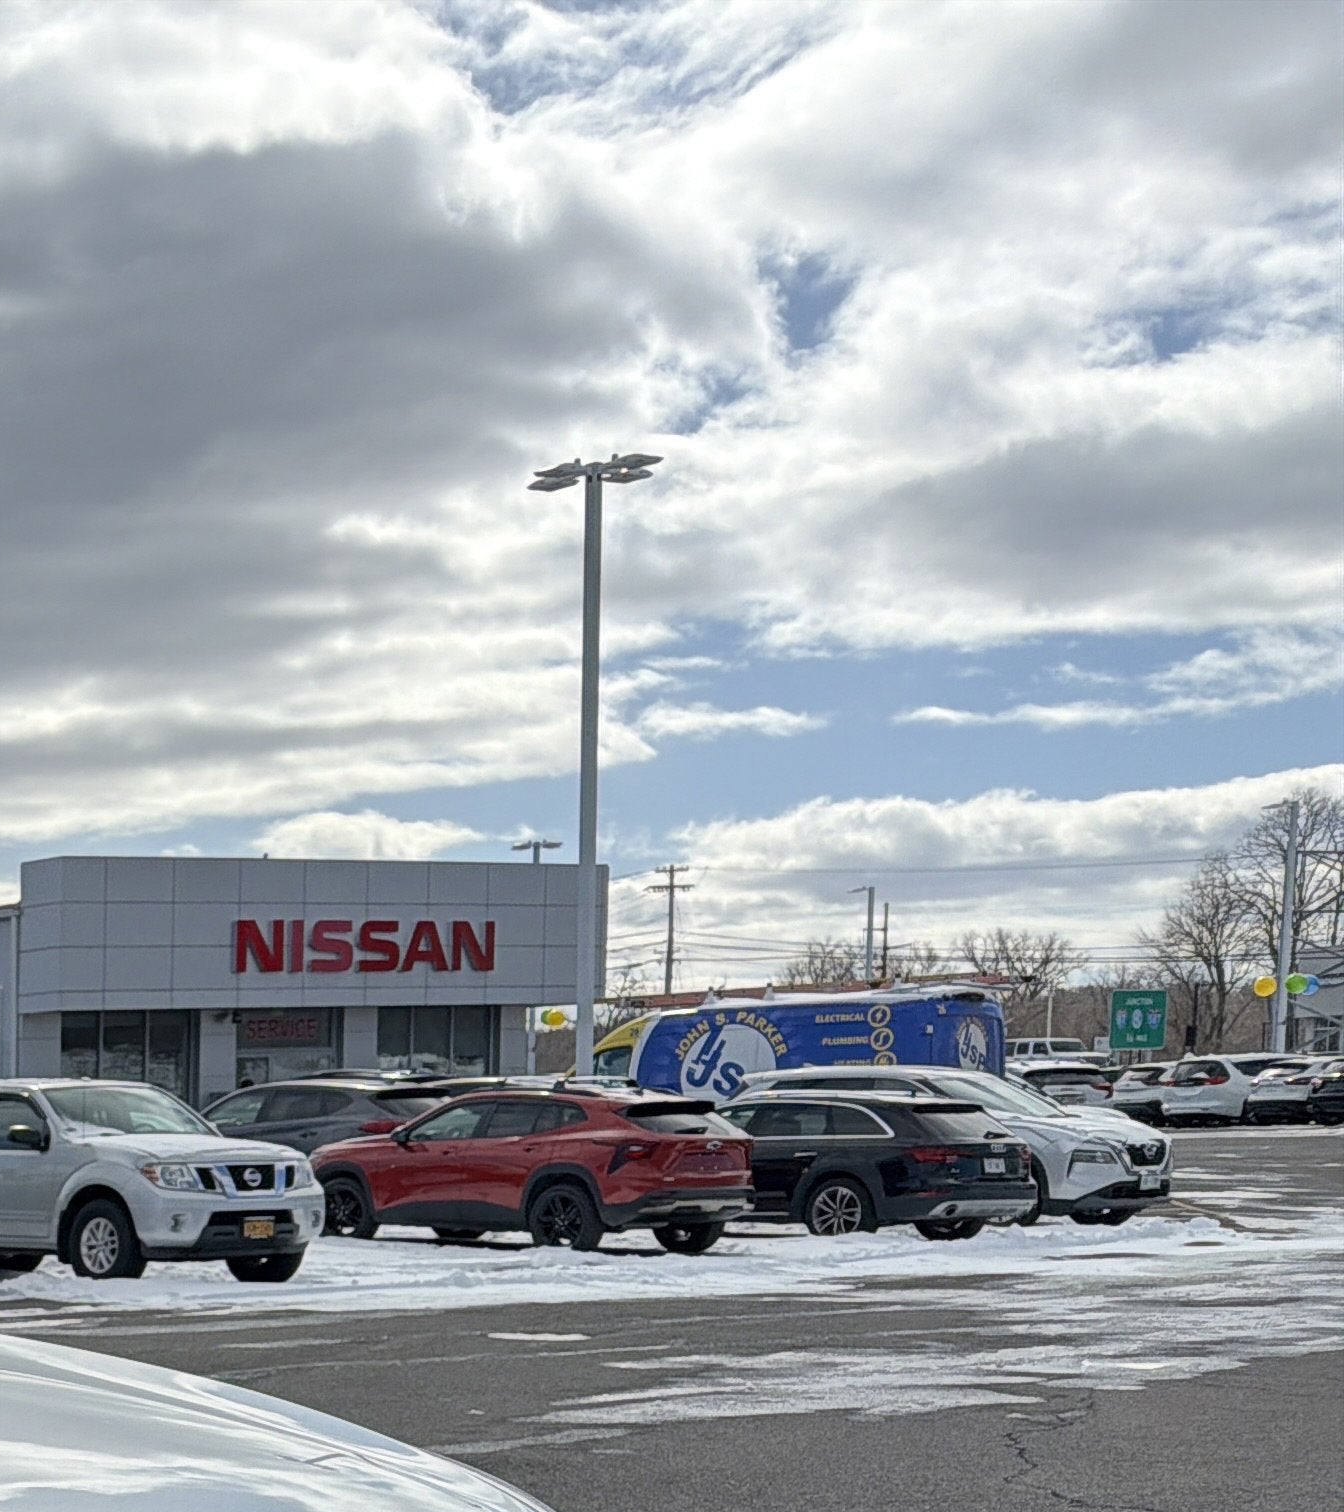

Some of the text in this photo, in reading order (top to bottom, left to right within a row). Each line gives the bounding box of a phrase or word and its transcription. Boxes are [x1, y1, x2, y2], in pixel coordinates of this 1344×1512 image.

[235, 919, 496, 974] NISSAN
[245, 1017, 319, 1041] SERVICE
[814, 1013, 866, 1024] ELECTRICAL
[674, 1010, 789, 1061] JOHN S. PARKER
[821, 1036, 869, 1046] PLUMBING
